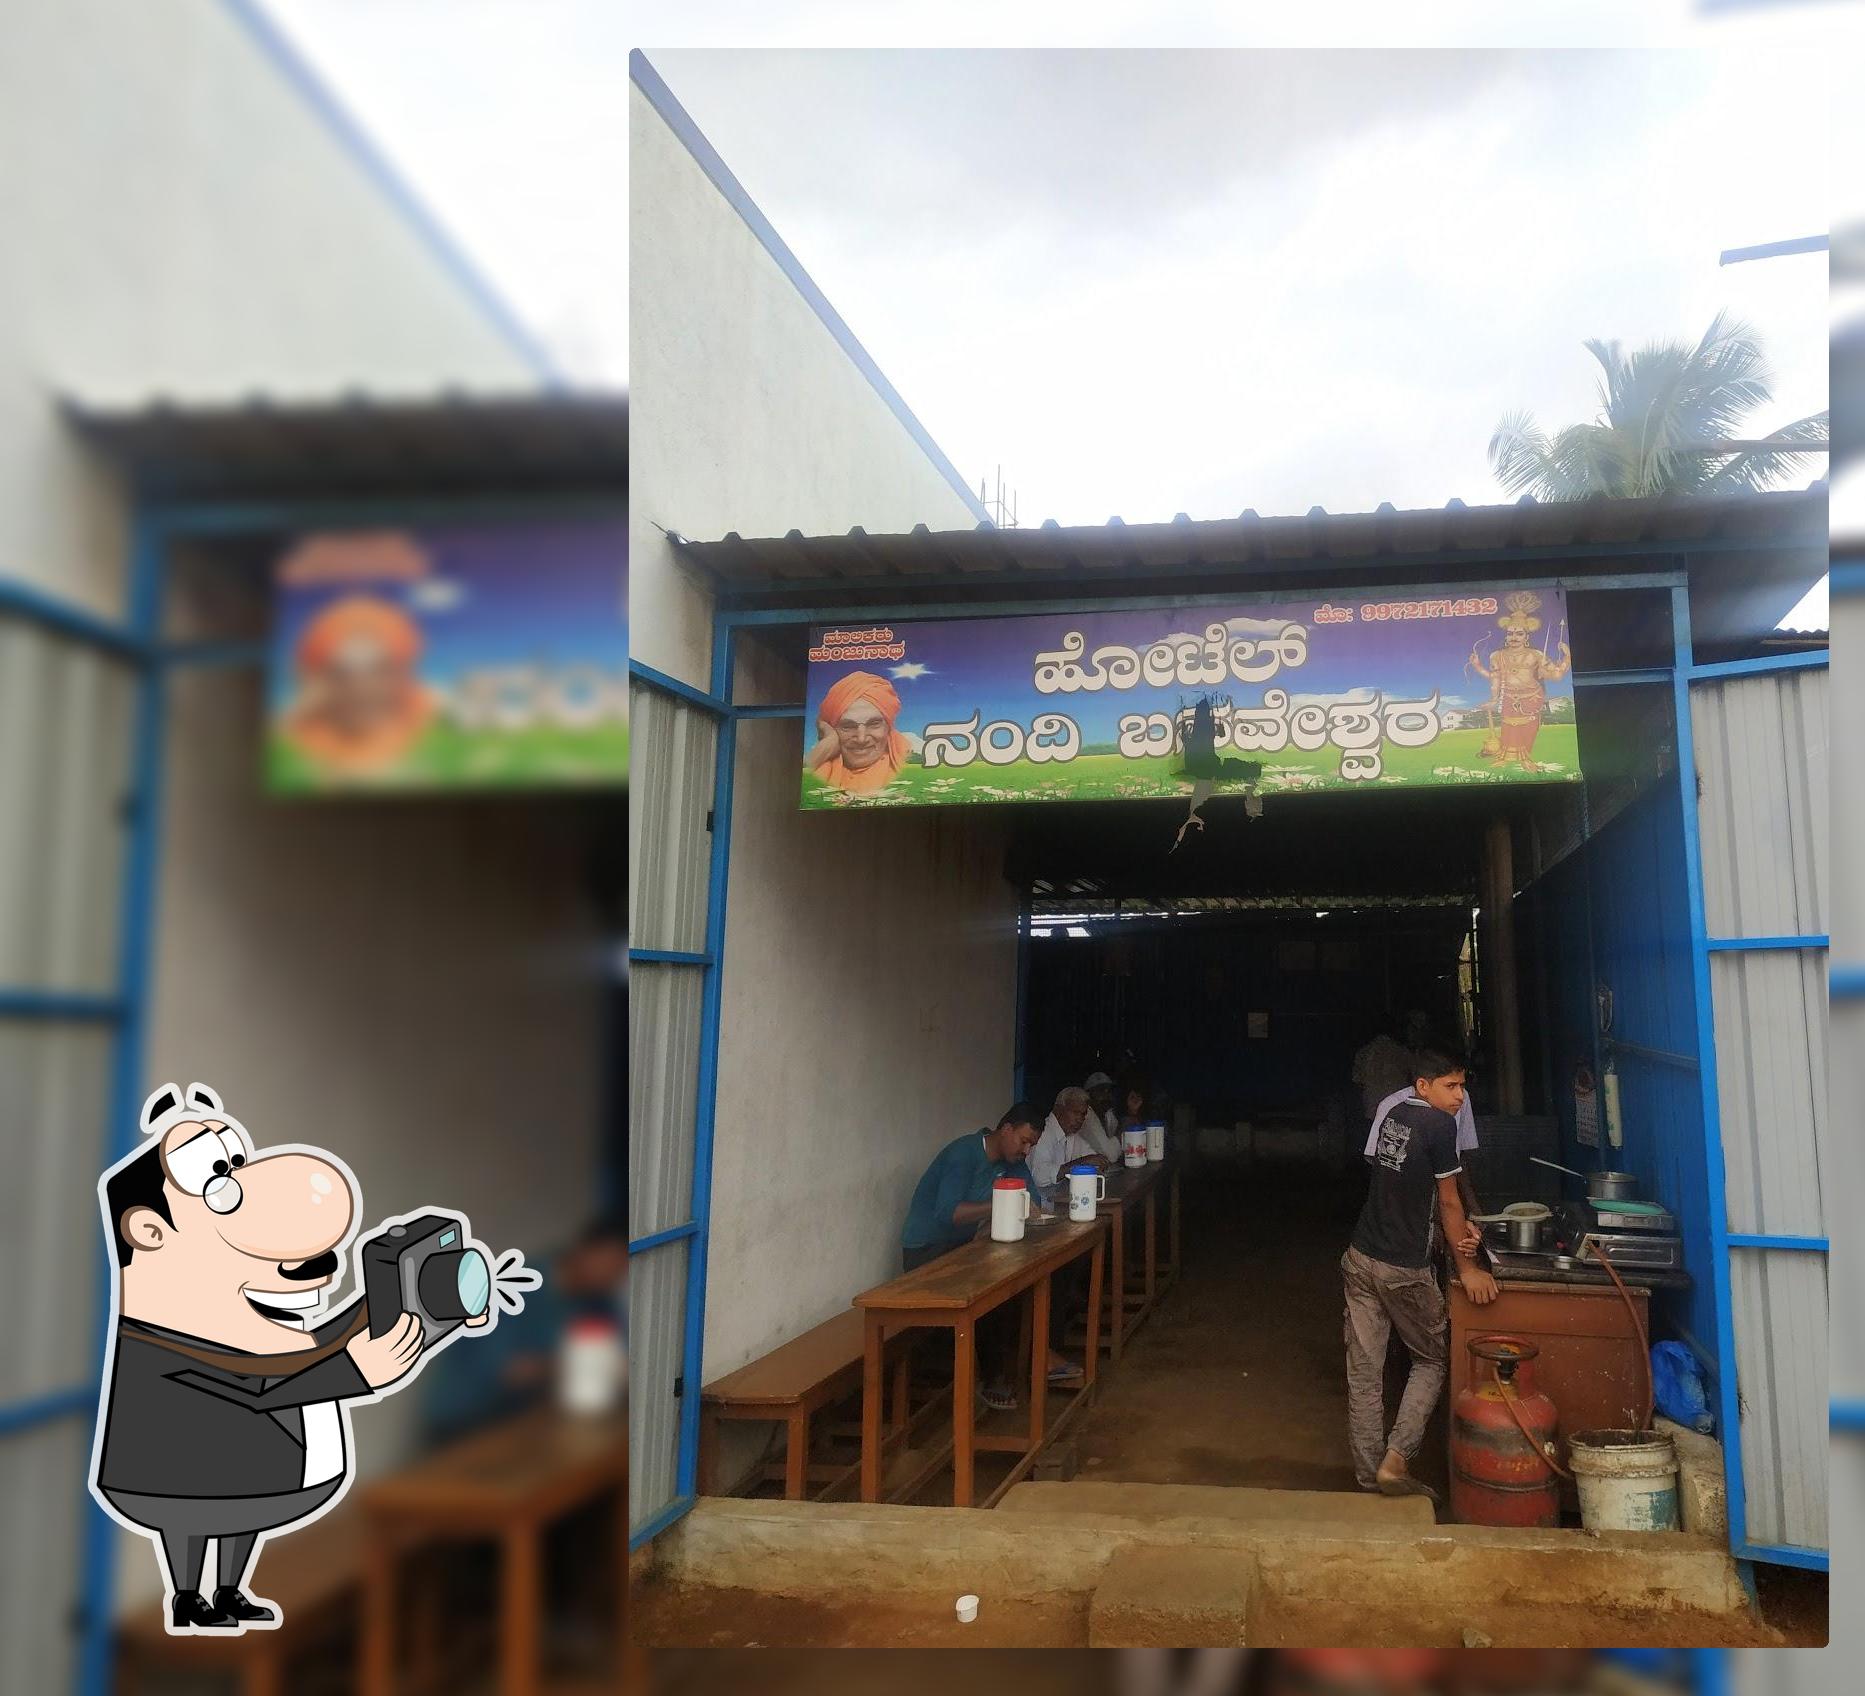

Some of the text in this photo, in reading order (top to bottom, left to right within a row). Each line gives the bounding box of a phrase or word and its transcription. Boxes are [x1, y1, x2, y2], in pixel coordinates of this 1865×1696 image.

[1360, 598, 1498, 622] 9972171432
[808, 640, 905, 662] ಮಂಜುನಾಥ
[1033, 622, 1309, 694] ಹೋಟೆಲ್
[922, 708, 1082, 768] ನಂದಿ
